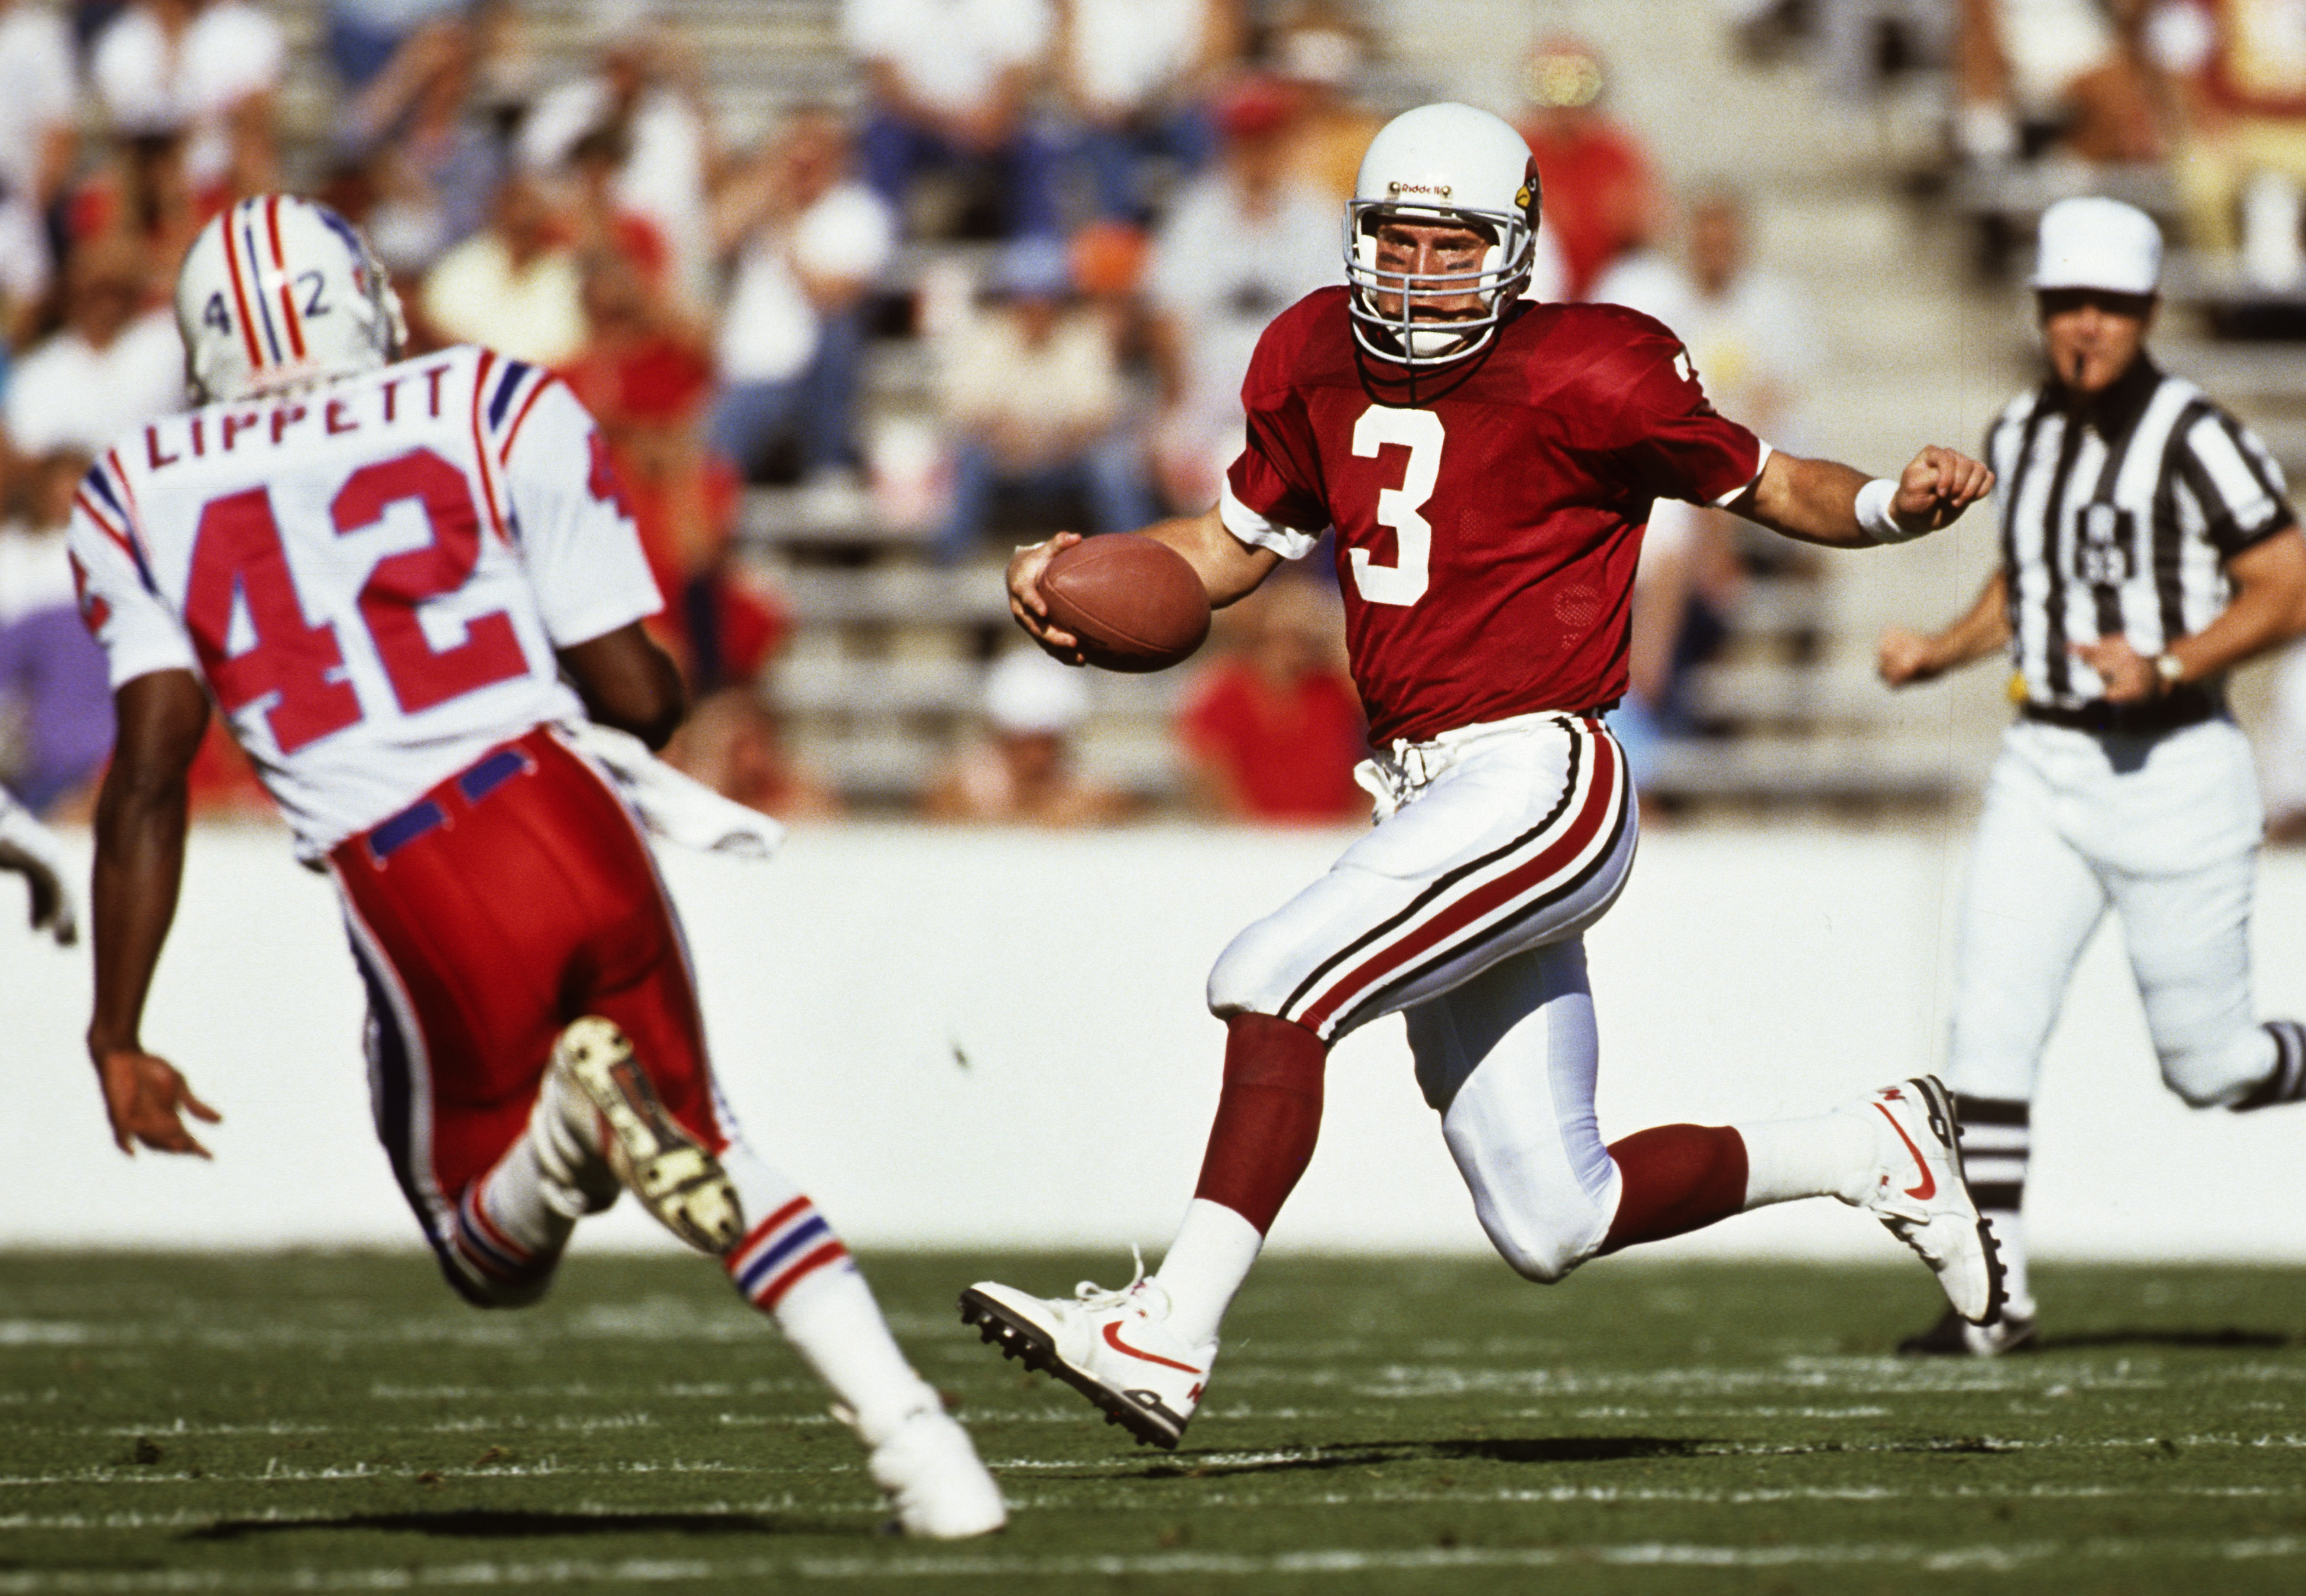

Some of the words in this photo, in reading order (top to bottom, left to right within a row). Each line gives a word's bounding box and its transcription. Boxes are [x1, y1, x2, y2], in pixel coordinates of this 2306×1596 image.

[1402, 183, 1440, 195] Riddell
[144, 363, 451, 471] LIPPETT
[1349, 404, 1445, 607] 3
[183, 446, 531, 756] 42
